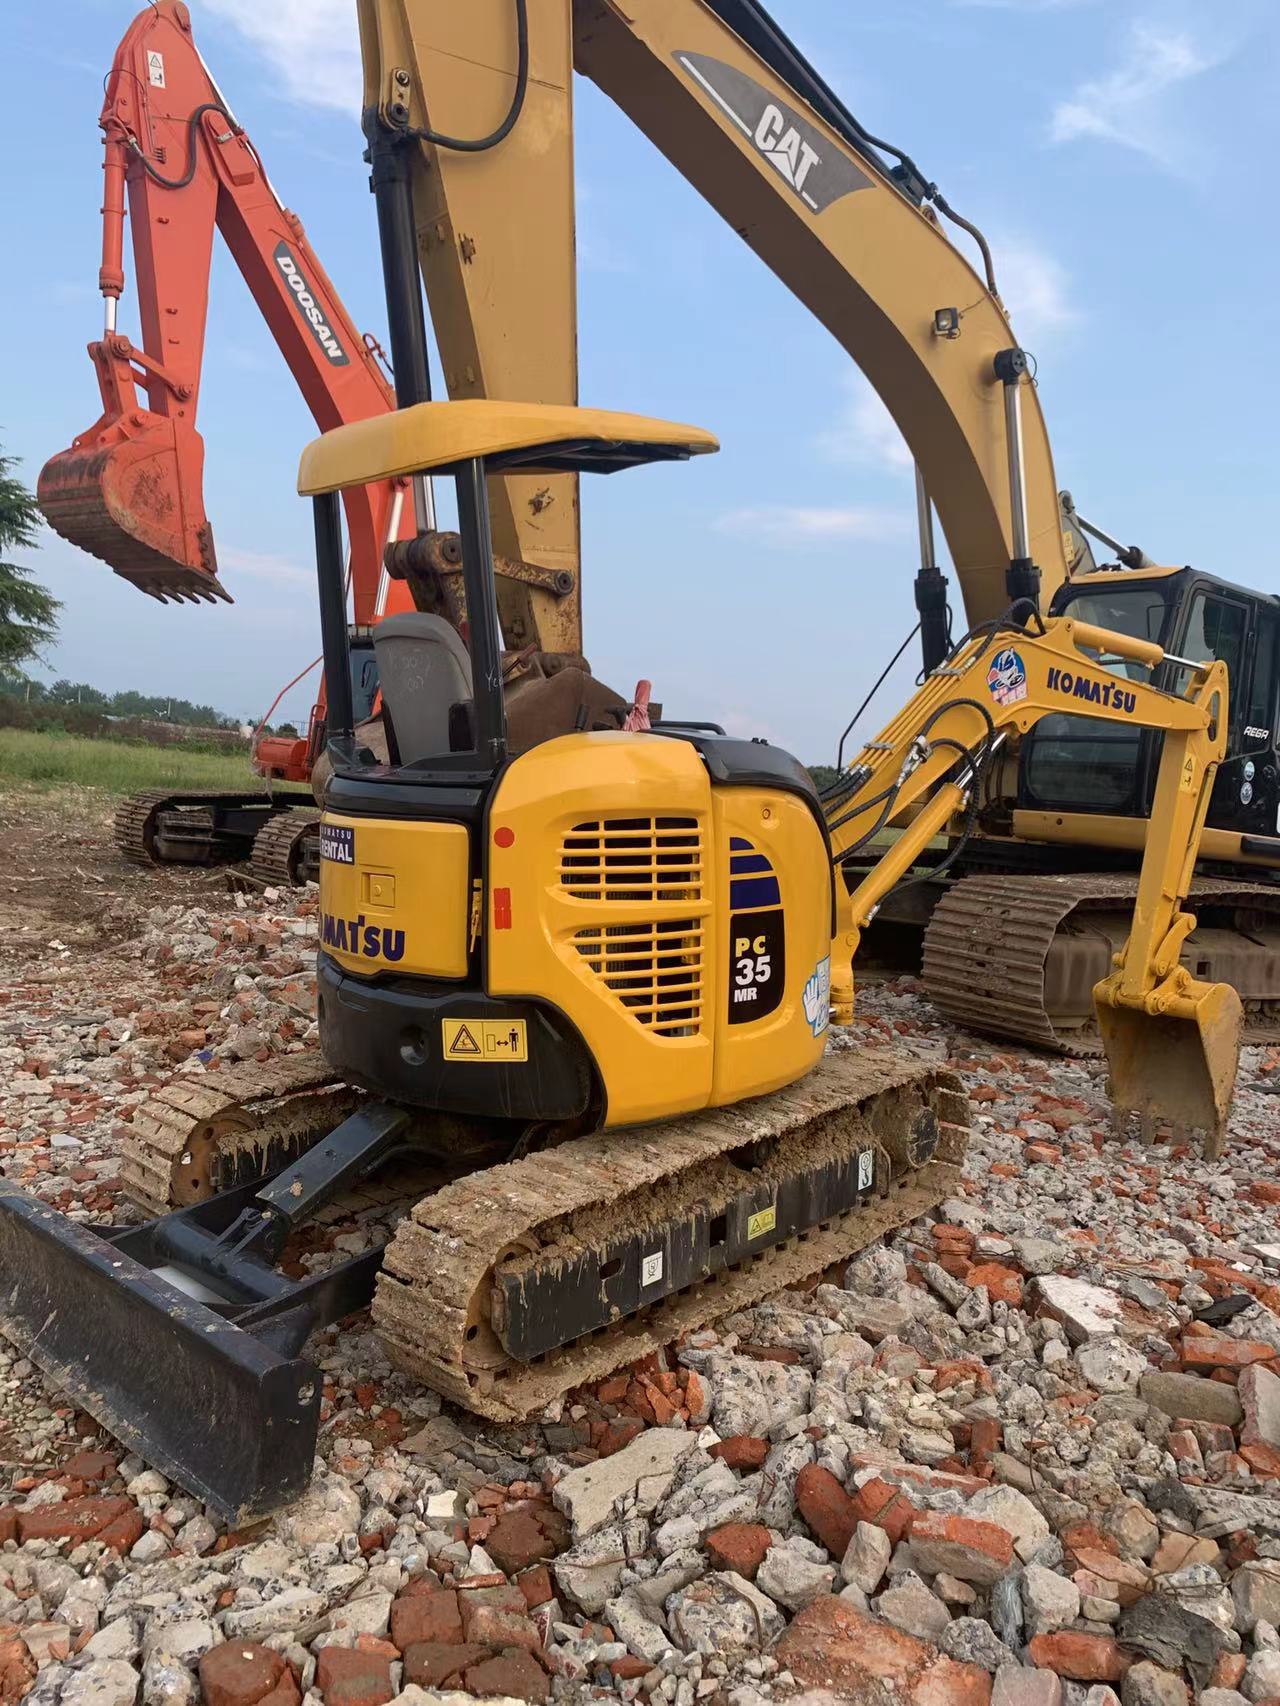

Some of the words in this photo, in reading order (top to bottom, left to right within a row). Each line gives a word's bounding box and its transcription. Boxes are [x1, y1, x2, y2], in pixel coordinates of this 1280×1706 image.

[755, 104, 820, 191] CAT
[277, 256, 342, 358] DOOSAN
[1047, 667, 1137, 713] KOMATSU
[321, 838, 353, 862] RENTAL
[320, 911, 406, 962] MATSU
[735, 935, 766, 957] PC
[735, 955, 772, 985] 35
[733, 987, 758, 1003] MR
